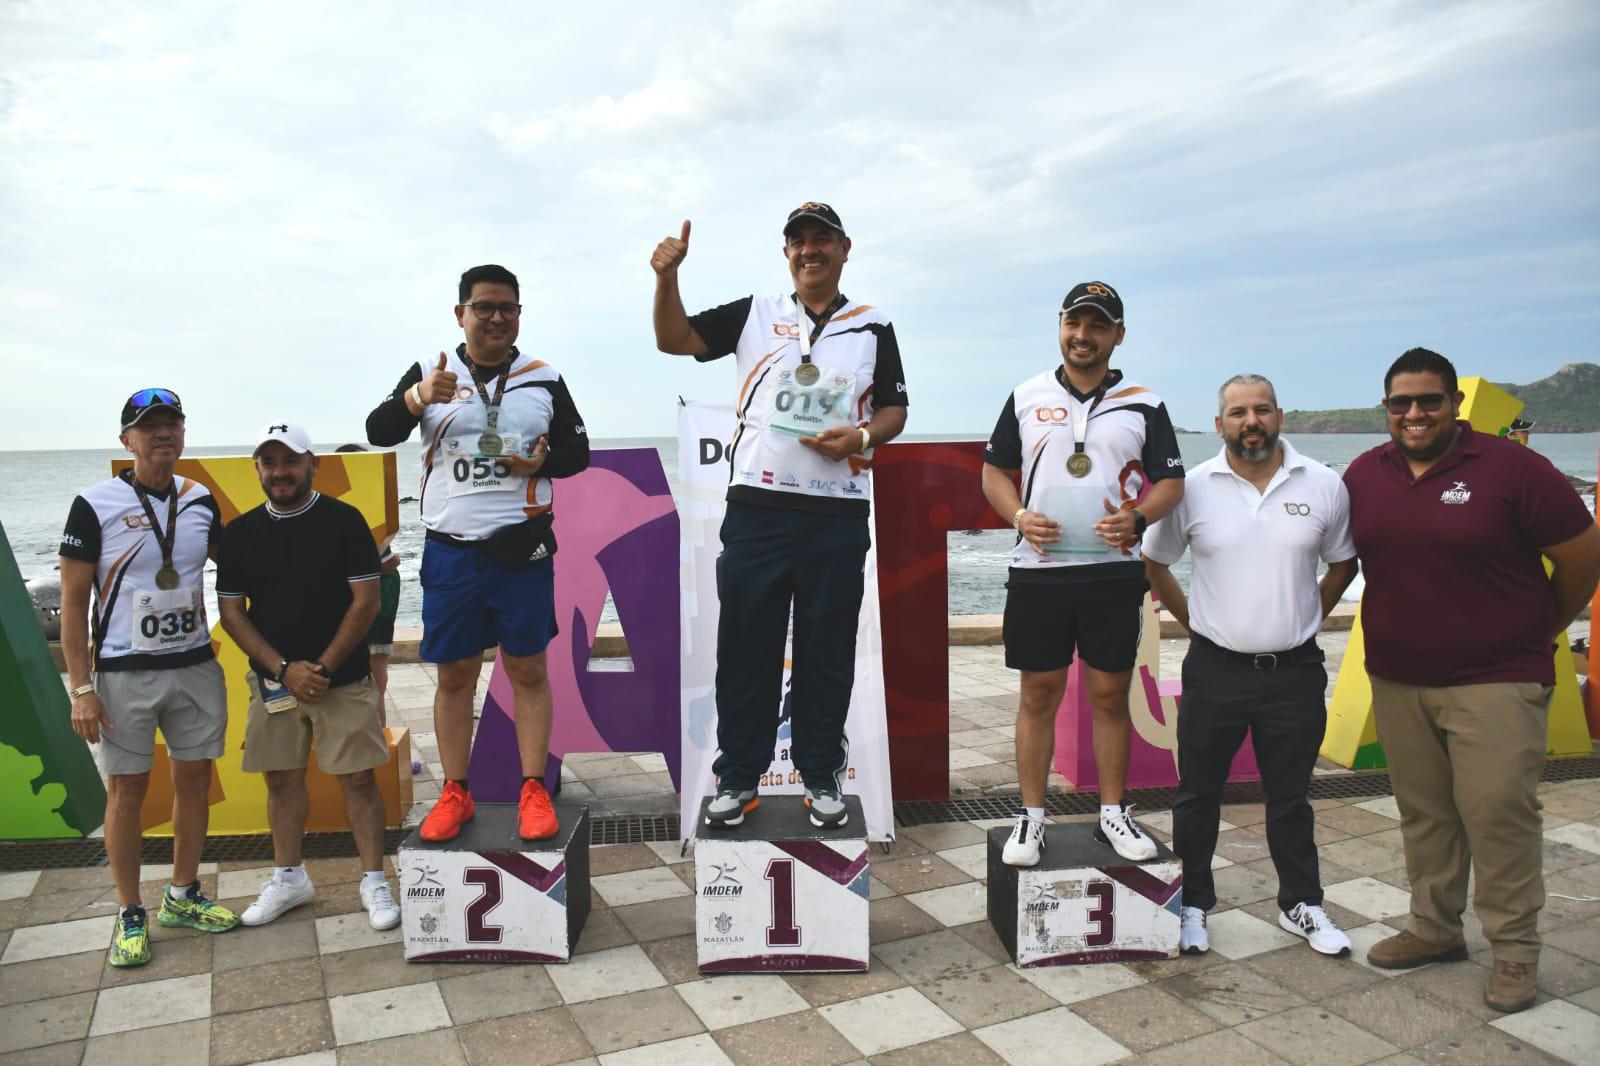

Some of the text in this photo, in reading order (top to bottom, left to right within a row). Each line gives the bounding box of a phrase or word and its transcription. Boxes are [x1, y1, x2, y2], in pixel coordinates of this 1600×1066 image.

[776, 390, 834, 415] 019
[793, 413, 823, 423] Deloitte
[473, 480, 501, 488] Deloitte
[140, 610, 196, 639] 038
[160, 635, 187, 644] Deloitte
[407, 887, 446, 897] IMDEM
[703, 885, 744, 896] IMDEM
[462, 866, 504, 944] 2
[762, 857, 802, 947] 1
[1026, 901, 1060, 911] IMDEM
[1083, 880, 1118, 949] 3
